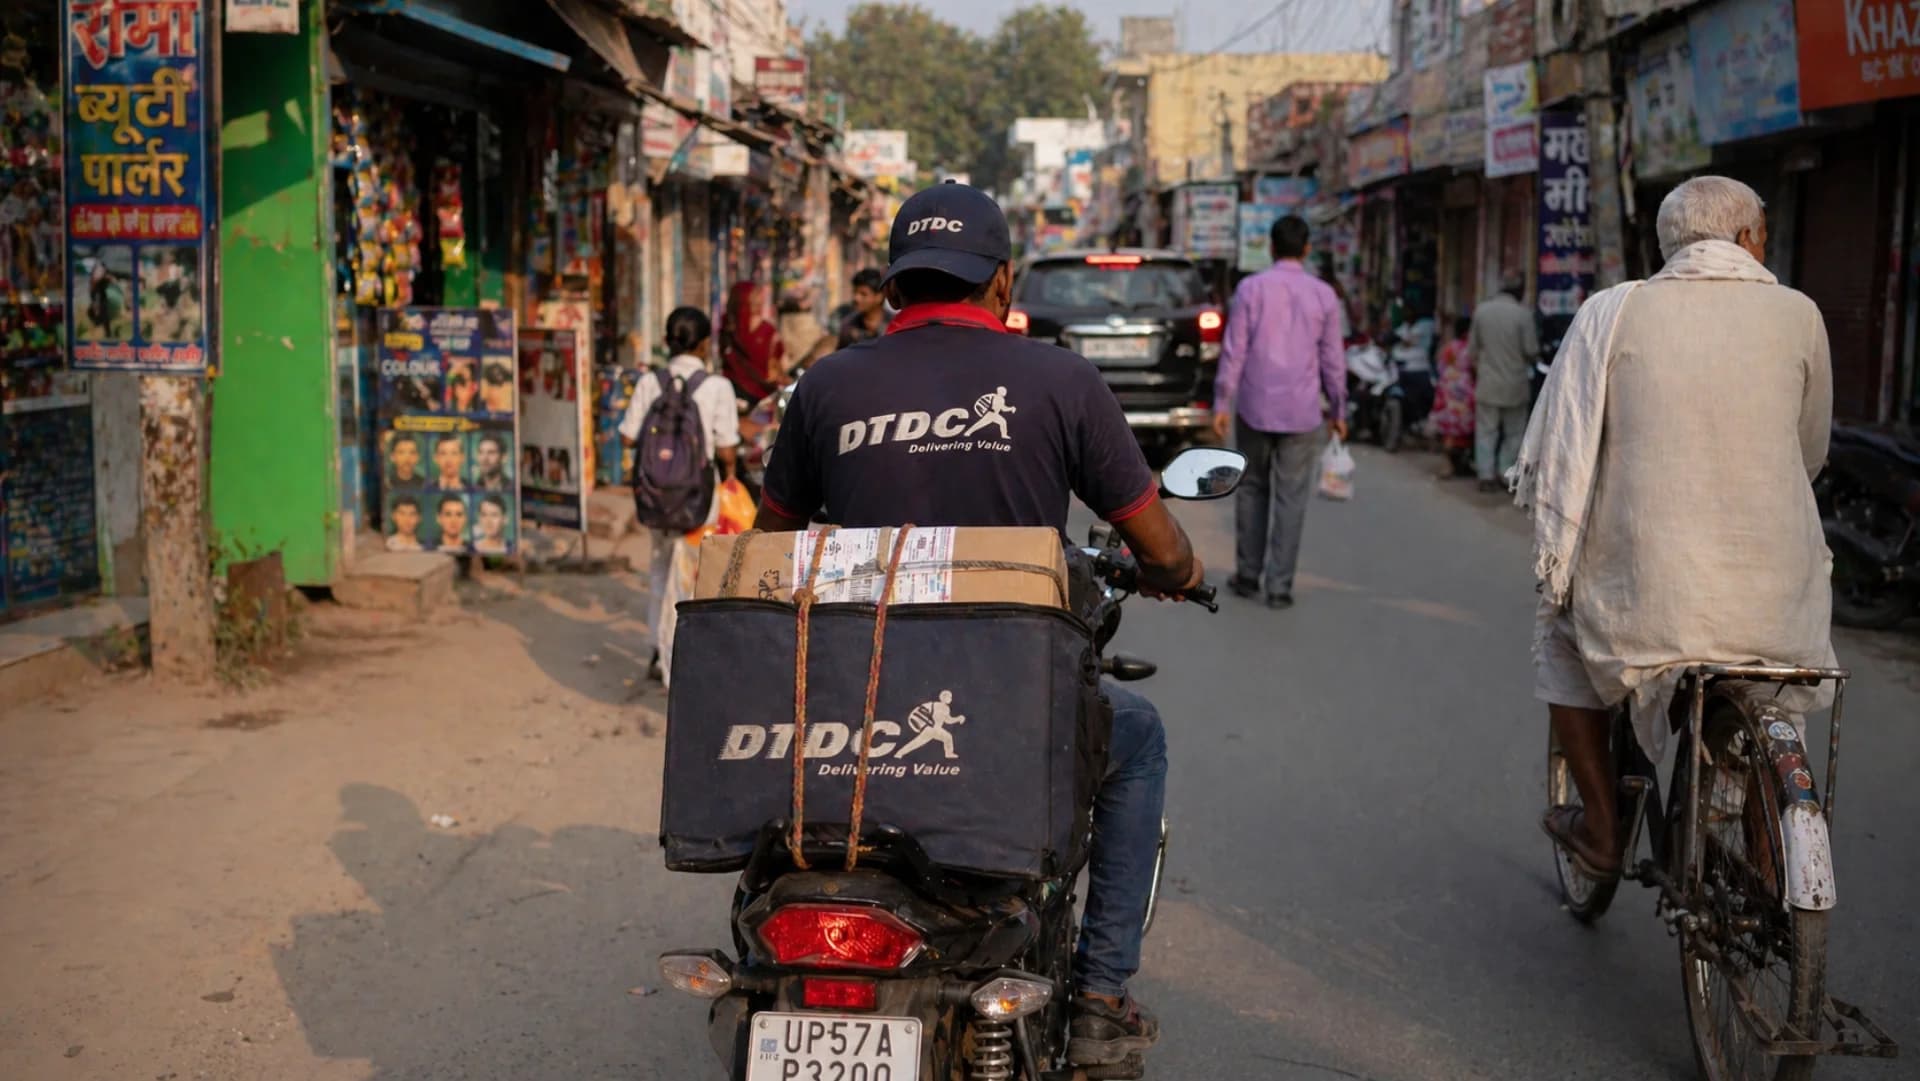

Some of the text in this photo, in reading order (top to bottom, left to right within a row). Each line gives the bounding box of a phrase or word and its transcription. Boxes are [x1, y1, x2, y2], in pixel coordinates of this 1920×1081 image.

[75, 67, 191, 144] ब्यूटी
[80, 138, 189, 197] पार्लर
[907, 217, 963, 236] DTDC
[838, 408, 969, 456] DTDC
[908, 440, 1011, 453] Delivering Value
[718, 720, 901, 760] DTDC
[913, 763, 960, 776] Value
[785, 1020, 892, 1057] UP57A
